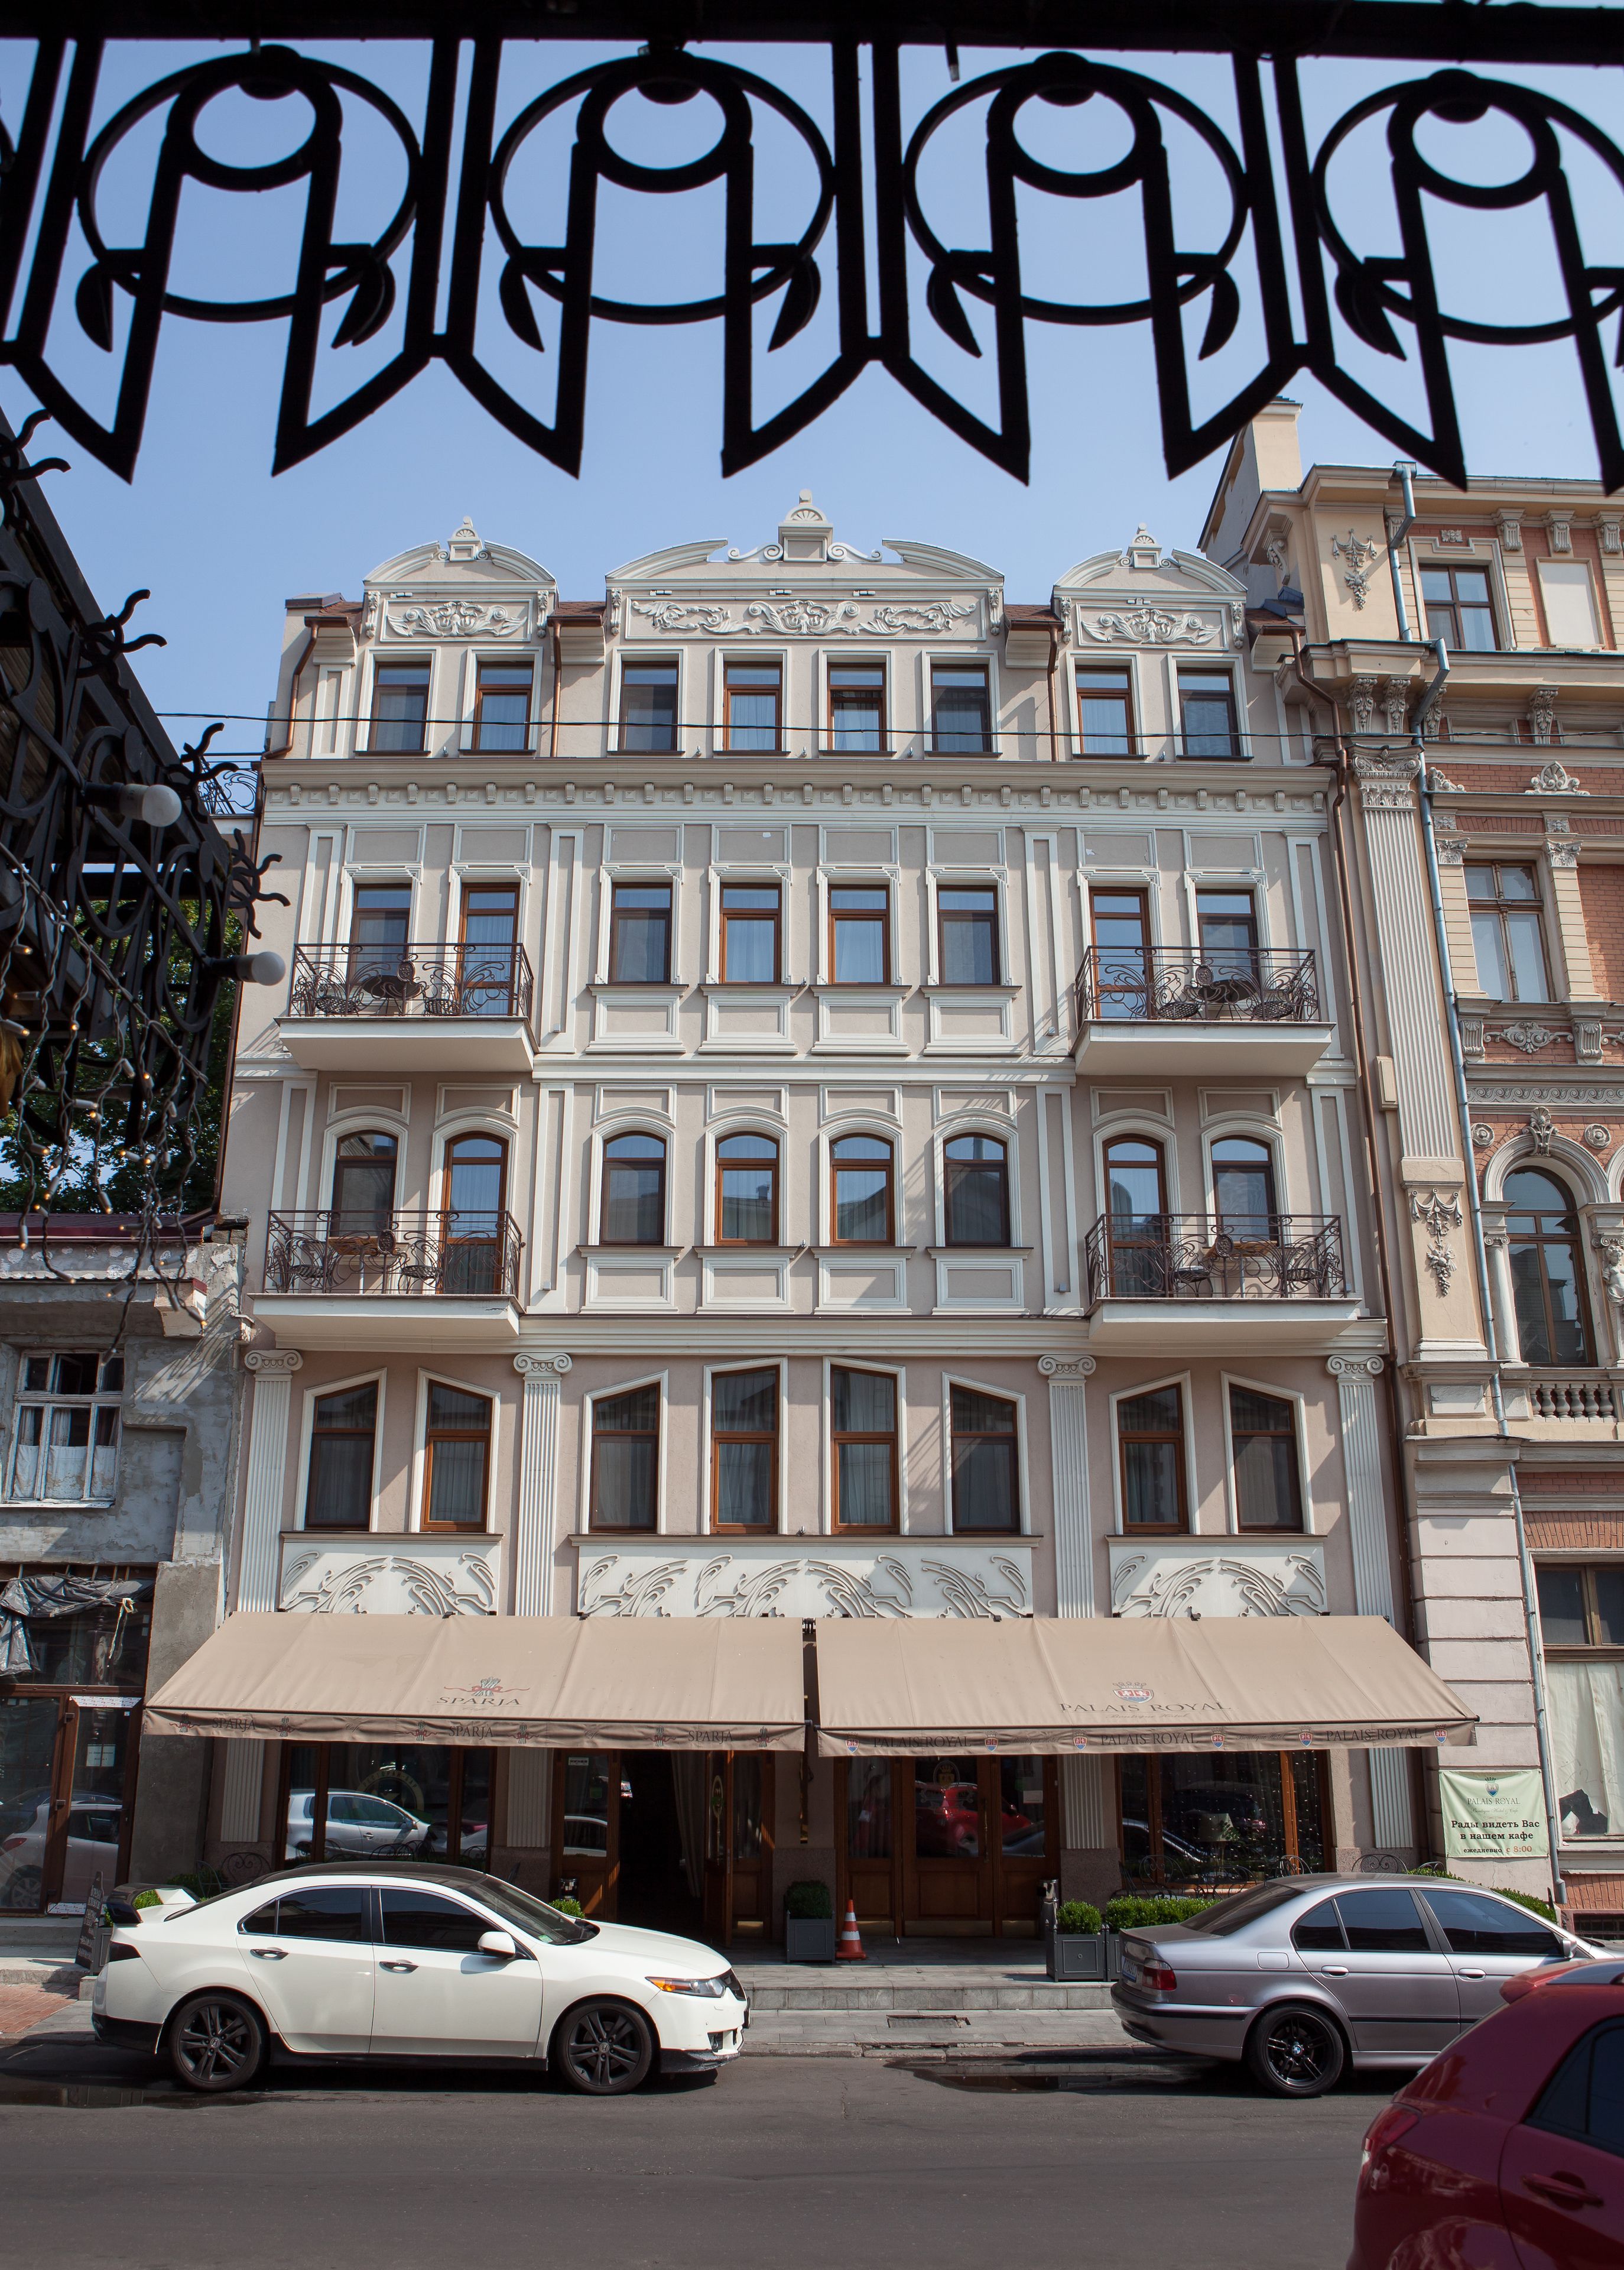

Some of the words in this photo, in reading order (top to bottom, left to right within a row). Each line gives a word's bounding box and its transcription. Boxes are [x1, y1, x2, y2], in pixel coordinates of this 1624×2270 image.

[436, 1697, 521, 1707] SPARJA
[1059, 1703, 1140, 1713] PALAIS
[1148, 1702, 1231, 1712] ROYAL
[212, 1717, 256, 1733] SPARJA
[449, 1726, 494, 1740] SPARJA
[688, 1730, 734, 1744] SPARJA
[1326, 1729, 1372, 1742] PALAIS
[1375, 1727, 1422, 1740] ROYAL
[873, 1737, 922, 1748] PALAIS
[923, 1736, 972, 1747] ROYAL
[1101, 1734, 1148, 1746] PALAIS
[1152, 1733, 1199, 1744] ROYAL
[1451, 1820, 1479, 1828] Рады
[1508, 1831, 1534, 1841] кафе
